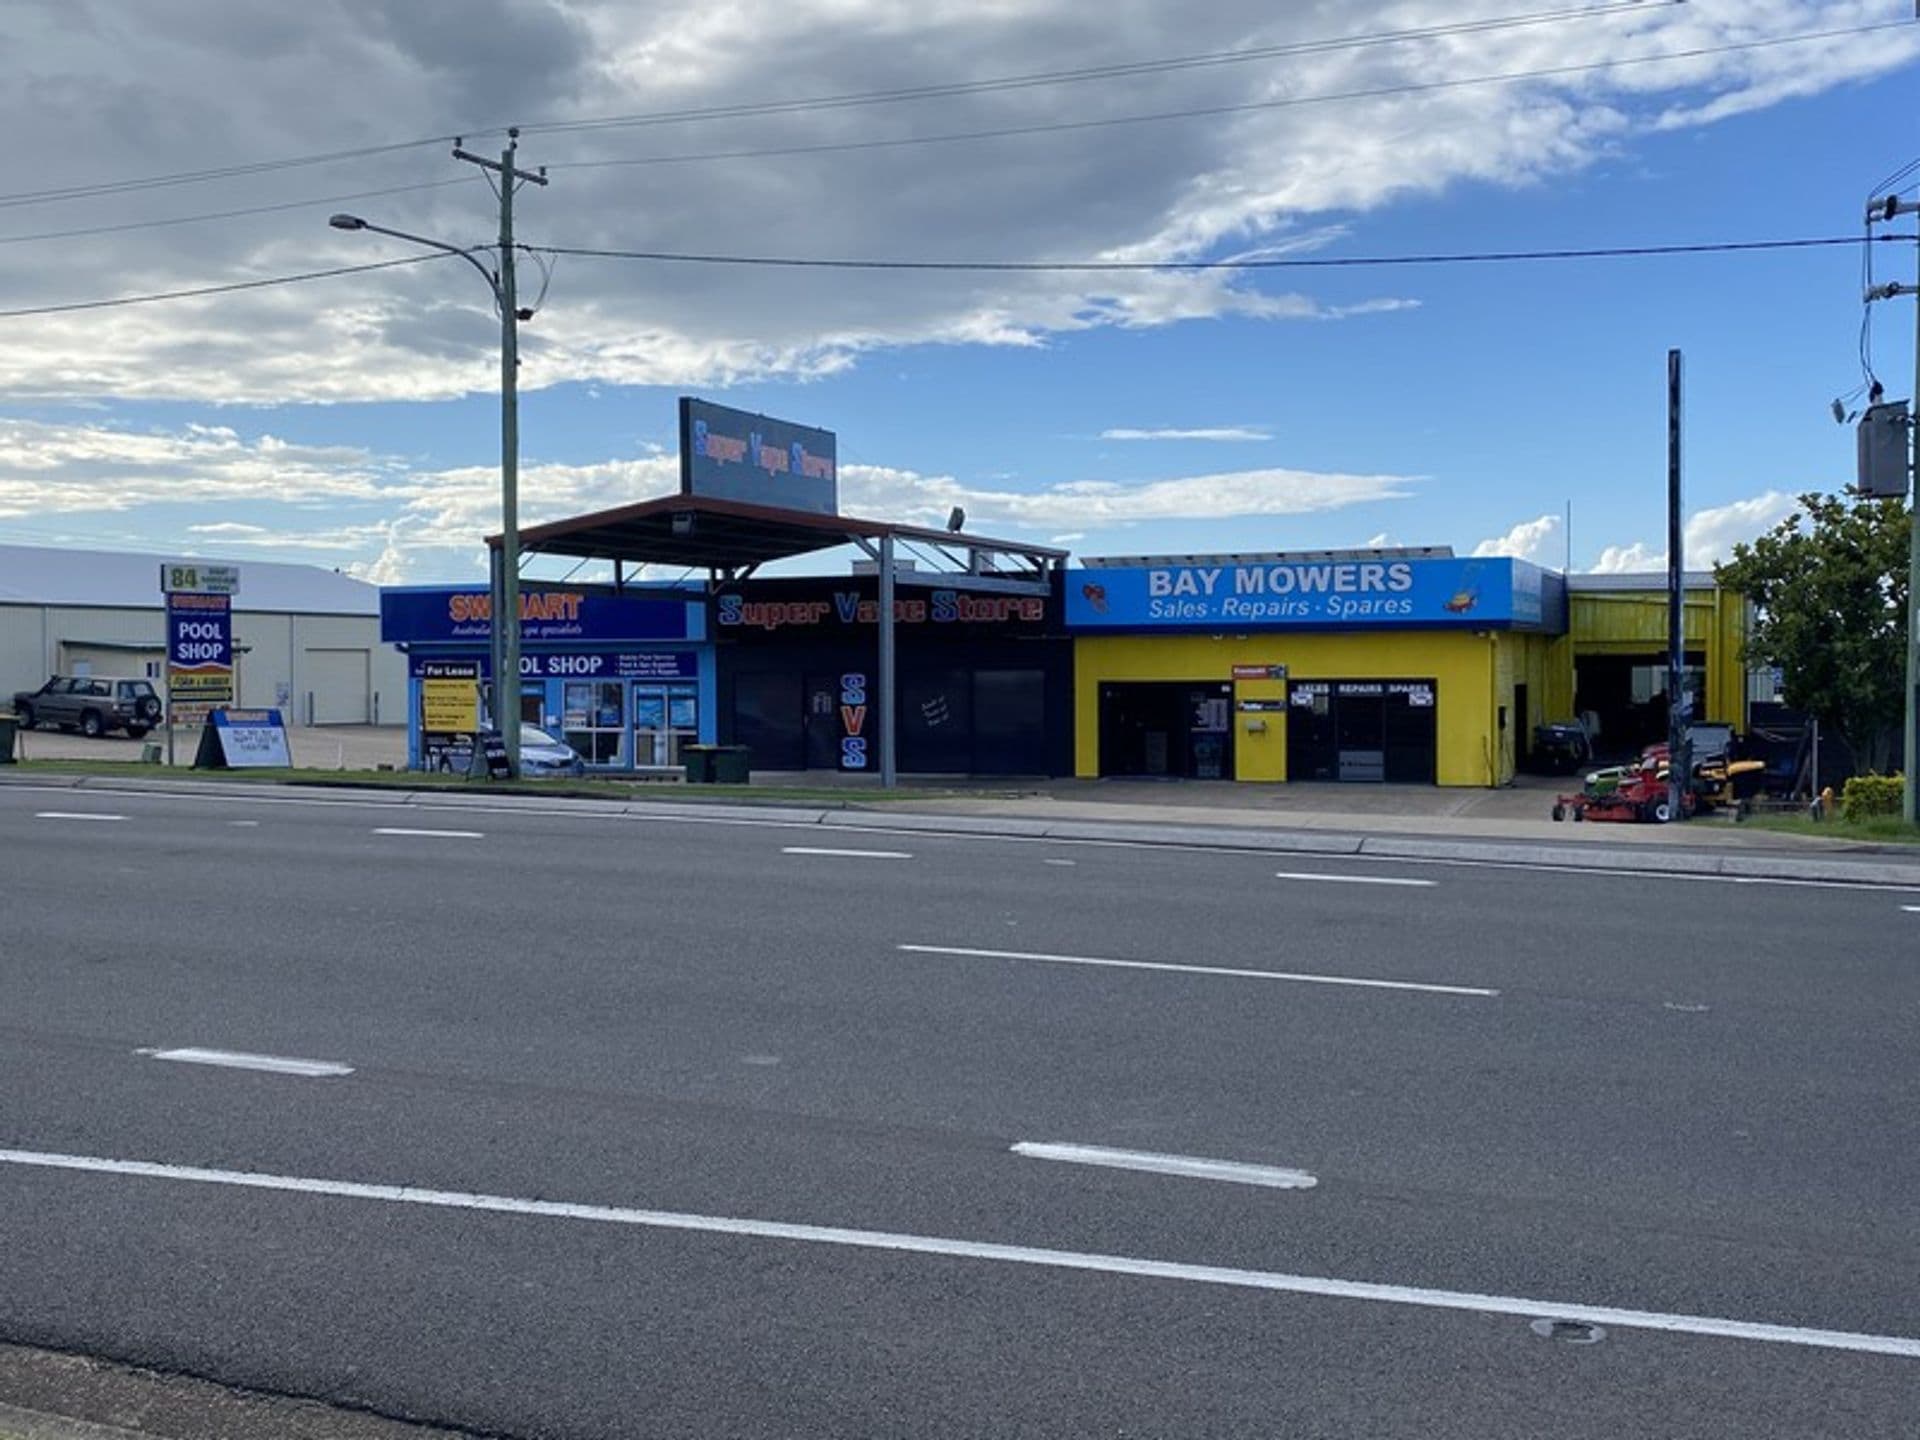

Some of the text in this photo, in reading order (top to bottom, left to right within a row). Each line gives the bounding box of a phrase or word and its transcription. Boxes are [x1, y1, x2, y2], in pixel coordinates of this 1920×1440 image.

[171, 567, 198, 589] 84
[1149, 563, 1413, 597] BAY MOWERS
[449, 592, 584, 622] SWART
[718, 593, 832, 631] Super
[931, 590, 1043, 622] Store
[1148, 595, 1413, 620] Sales Repairs Spares
[178, 622, 224, 640] POOL
[177, 642, 225, 660] SHOP
[427, 666, 443, 676] For
[444, 666, 475, 676] Lease
[548, 655, 604, 674] SHOP
[1297, 683, 1430, 694] SALES REPAIRS SPARES
